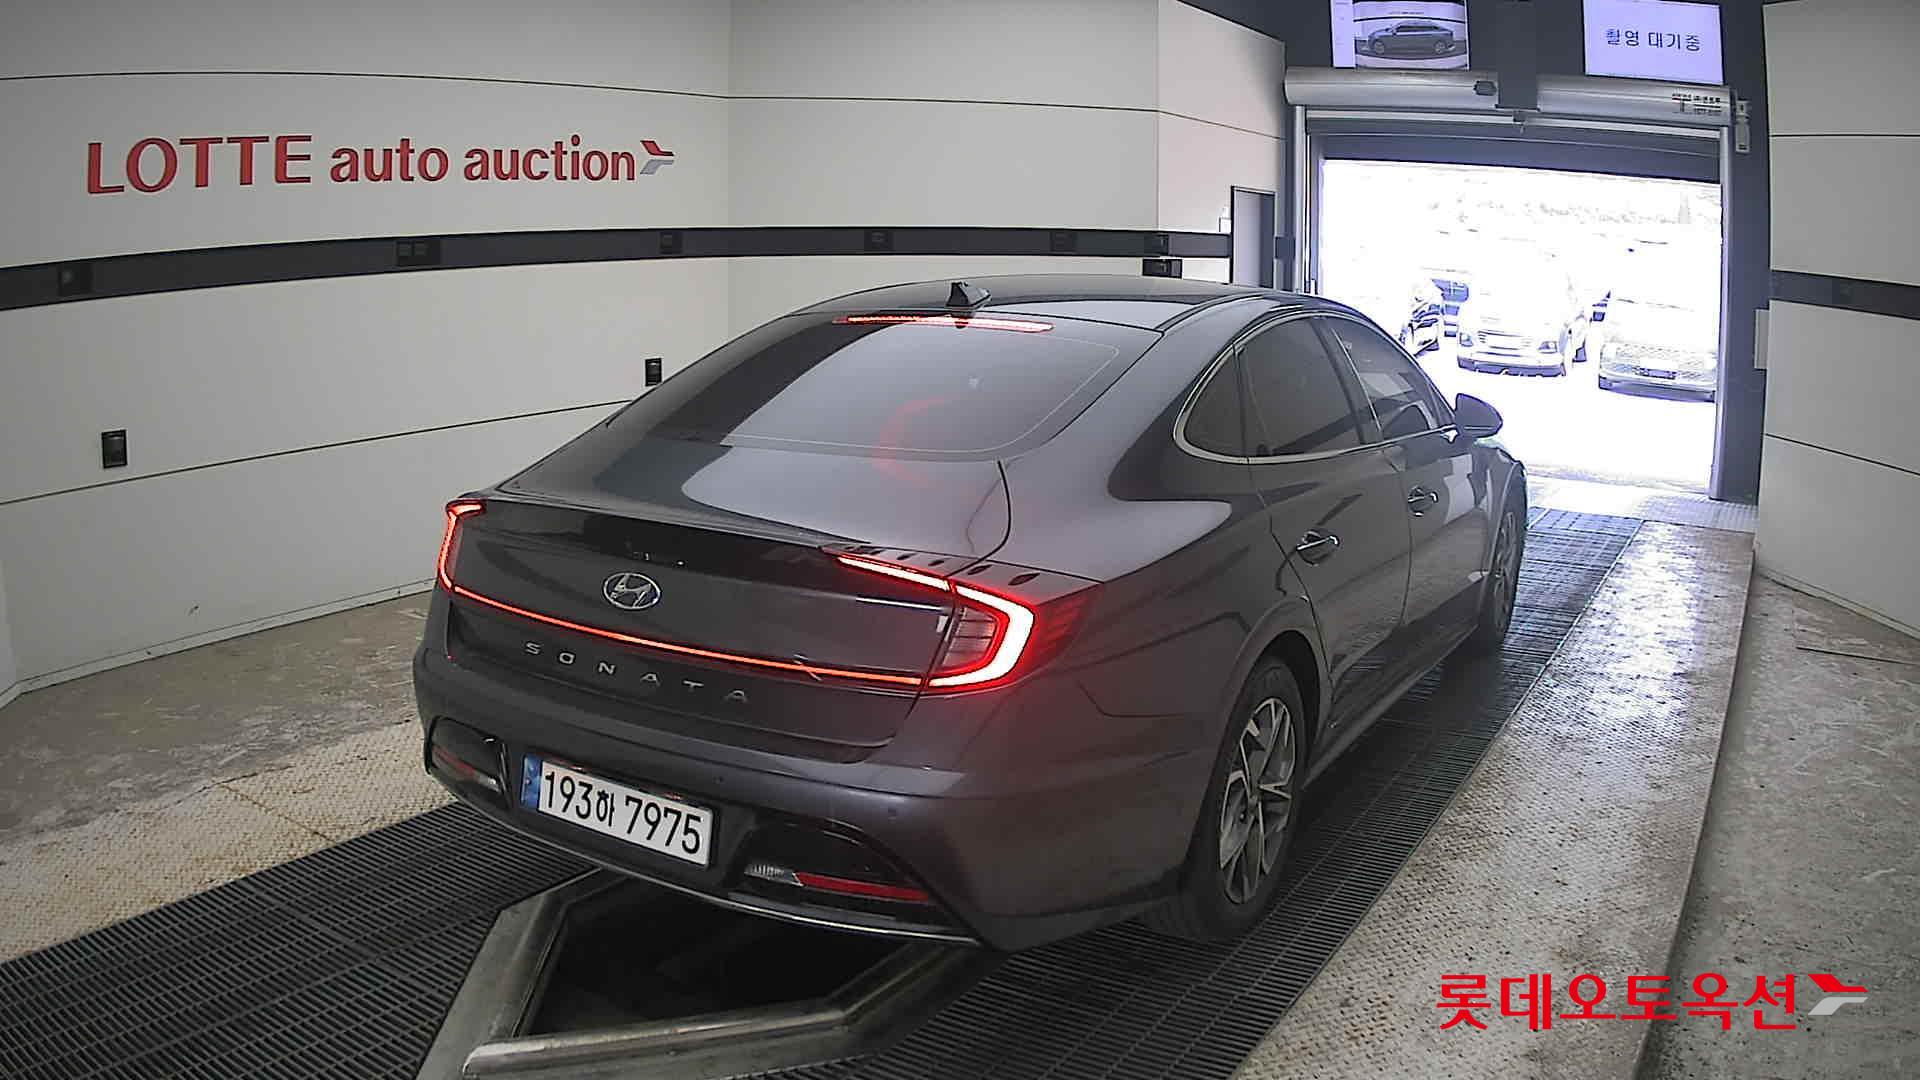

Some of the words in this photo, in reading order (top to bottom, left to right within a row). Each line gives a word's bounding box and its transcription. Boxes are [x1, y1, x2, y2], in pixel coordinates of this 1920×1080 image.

[88, 135, 312, 194] LOTTE
[330, 138, 449, 182] auto
[463, 134, 635, 182] auction
[525, 642, 748, 704] SONATA
[544, 771, 615, 827] 193하
[625, 797, 703, 855] 7975
